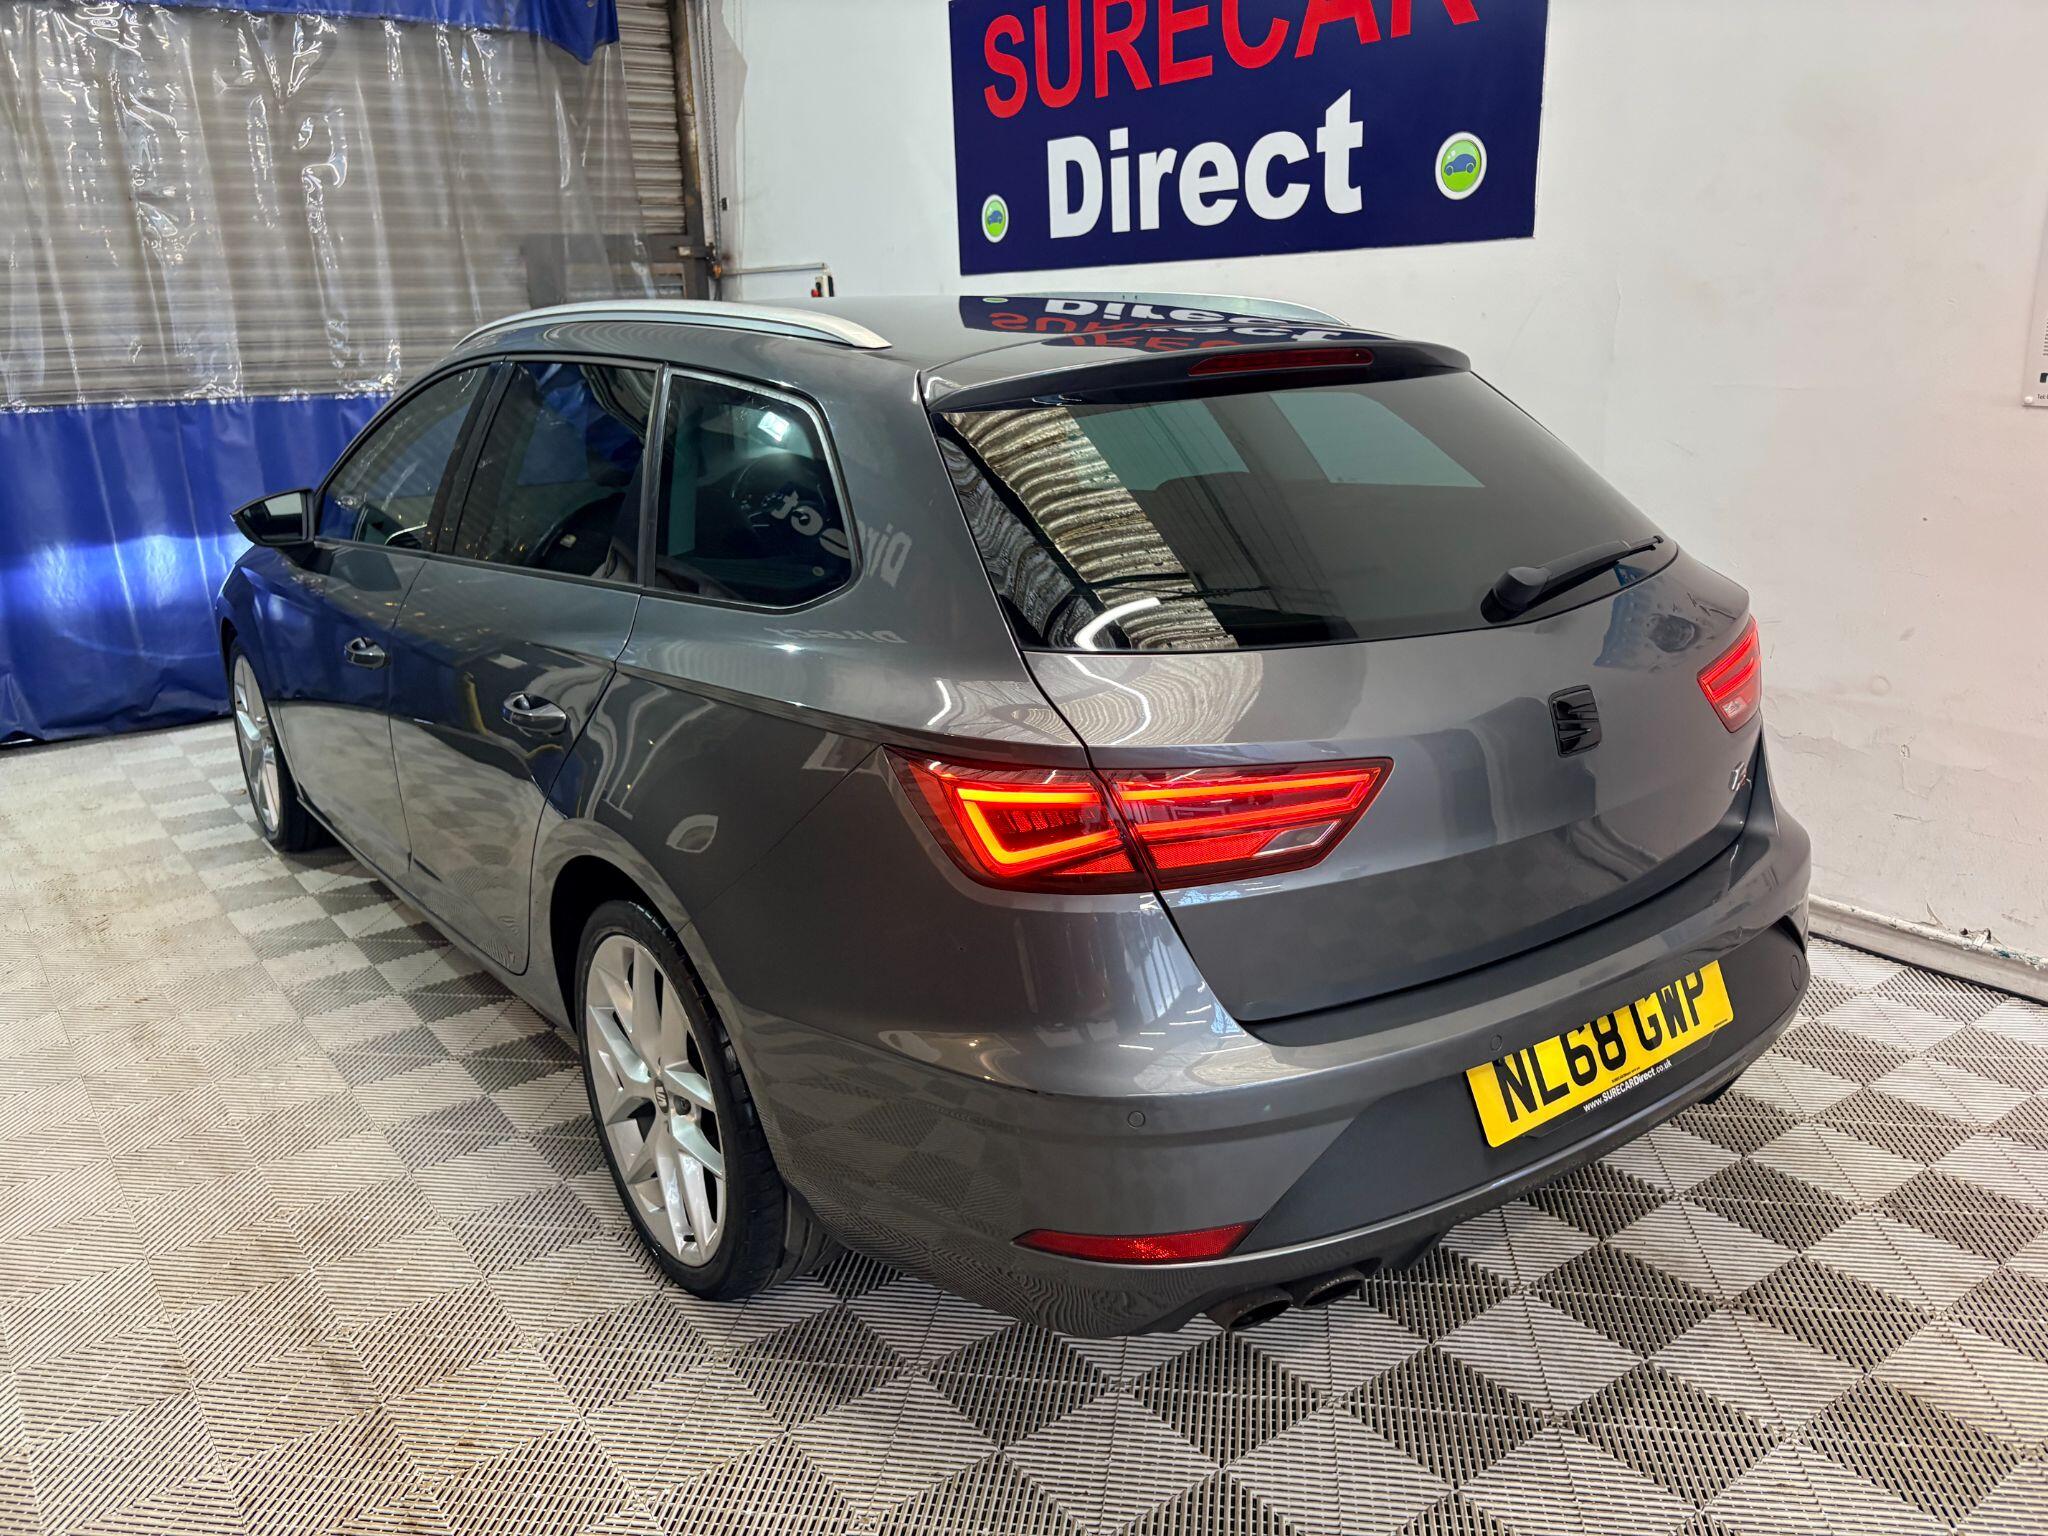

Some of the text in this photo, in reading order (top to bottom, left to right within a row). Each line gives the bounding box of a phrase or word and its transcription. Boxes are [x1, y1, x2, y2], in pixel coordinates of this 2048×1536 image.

[983, 0, 1479, 118] SUREC
[1047, 89, 1364, 239] Direct
[1491, 969, 1704, 1123] NL68 GWP
[1583, 1059, 1673, 1112] www.SURECARDirect.co.uk
